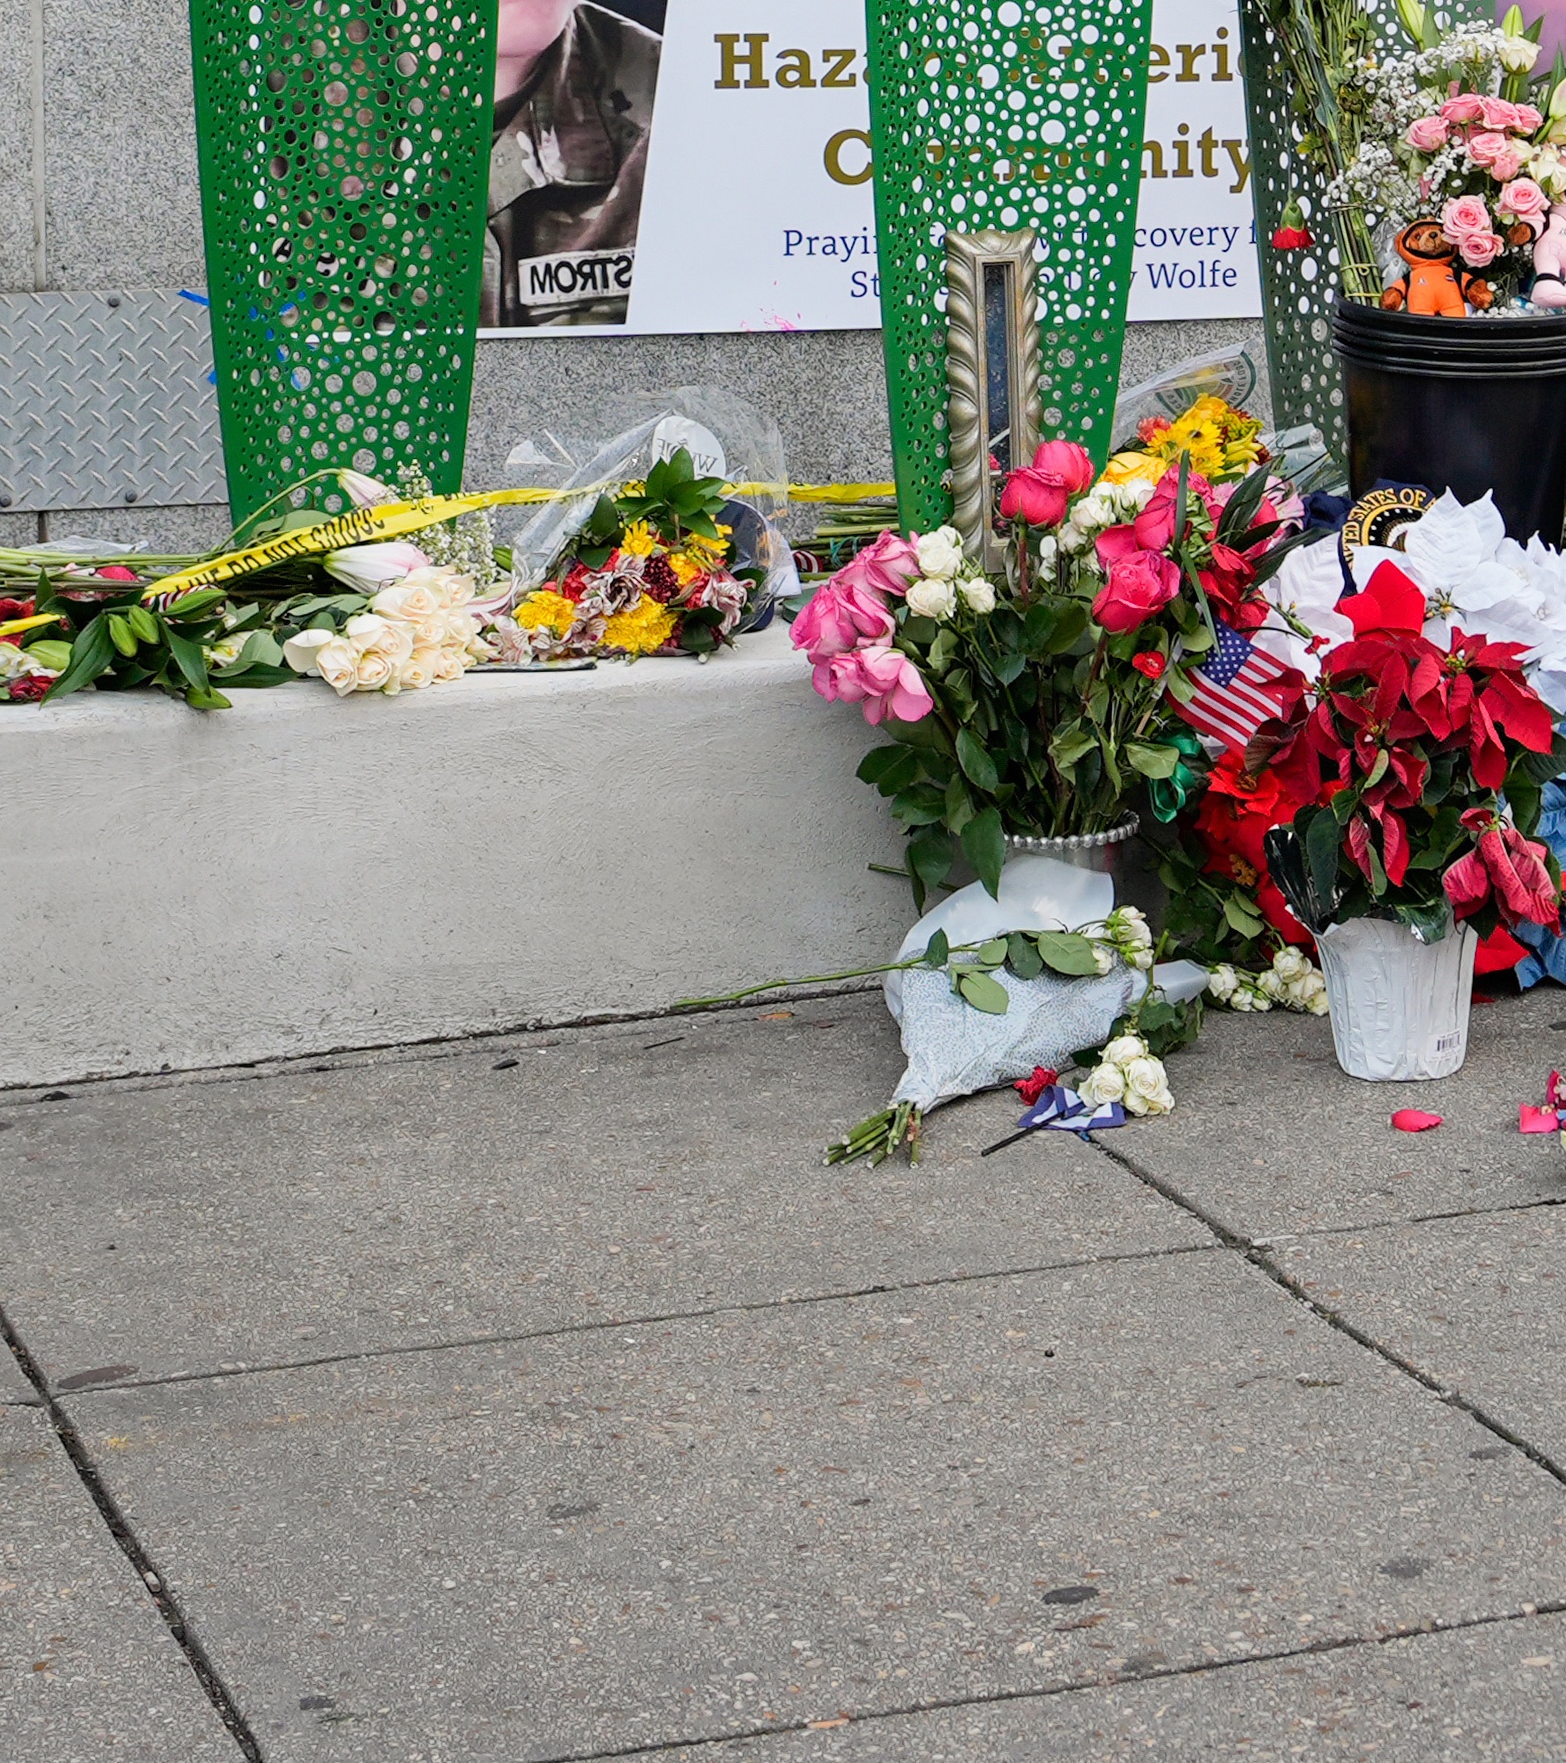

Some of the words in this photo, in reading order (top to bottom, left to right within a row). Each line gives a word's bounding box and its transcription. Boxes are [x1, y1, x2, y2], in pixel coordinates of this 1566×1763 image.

[1144, 260, 1237, 290] Wolfe
[1348, 487, 1398, 523] STATES
[1399, 487, 1427, 509] OF
